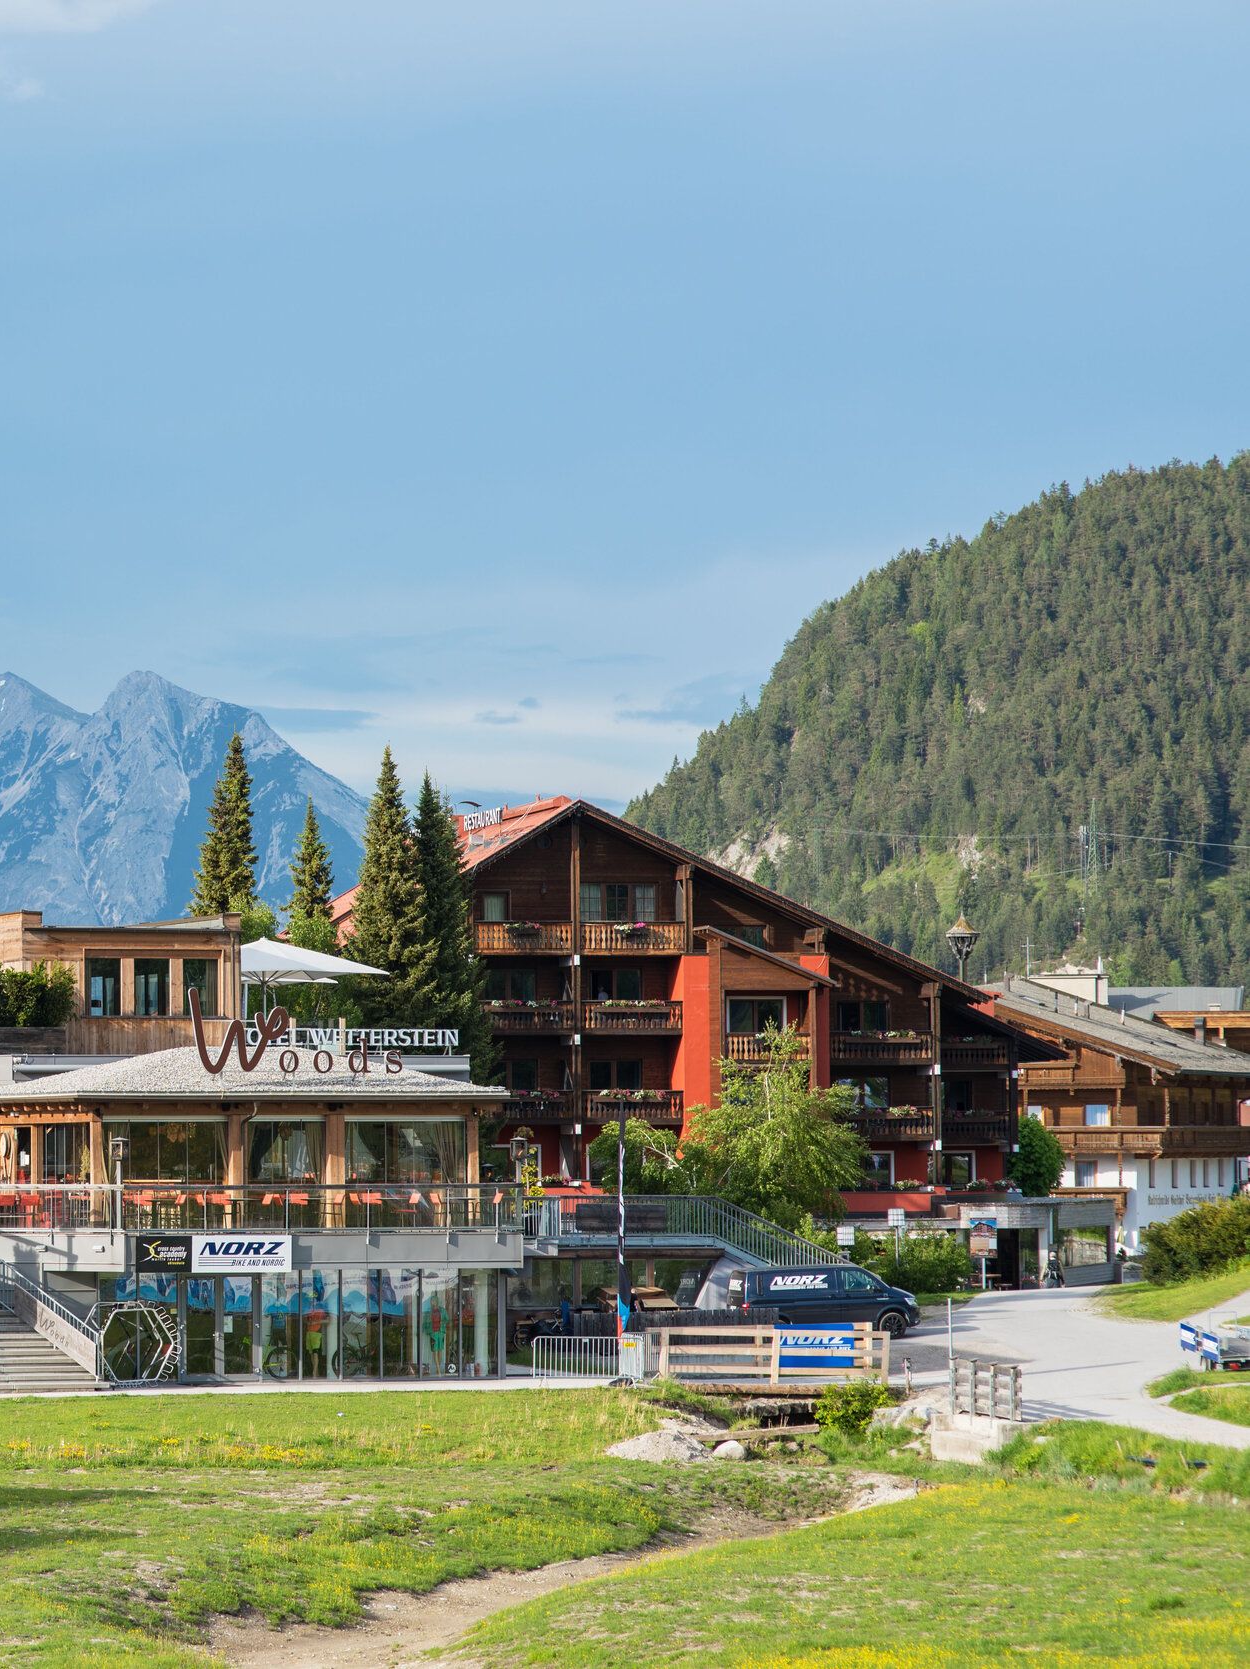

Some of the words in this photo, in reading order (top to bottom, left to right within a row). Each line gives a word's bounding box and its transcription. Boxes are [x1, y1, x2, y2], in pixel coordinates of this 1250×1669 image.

[463, 807, 501, 831] RESTAURANT
[188, 987, 403, 1074] Woods
[200, 1242, 285, 1255] NORZ
[231, 1259, 247, 1267] BIKE
[247, 1259, 261, 1267] AND
[261, 1259, 286, 1267] NORDIC
[770, 1274, 828, 1286] NORZ
